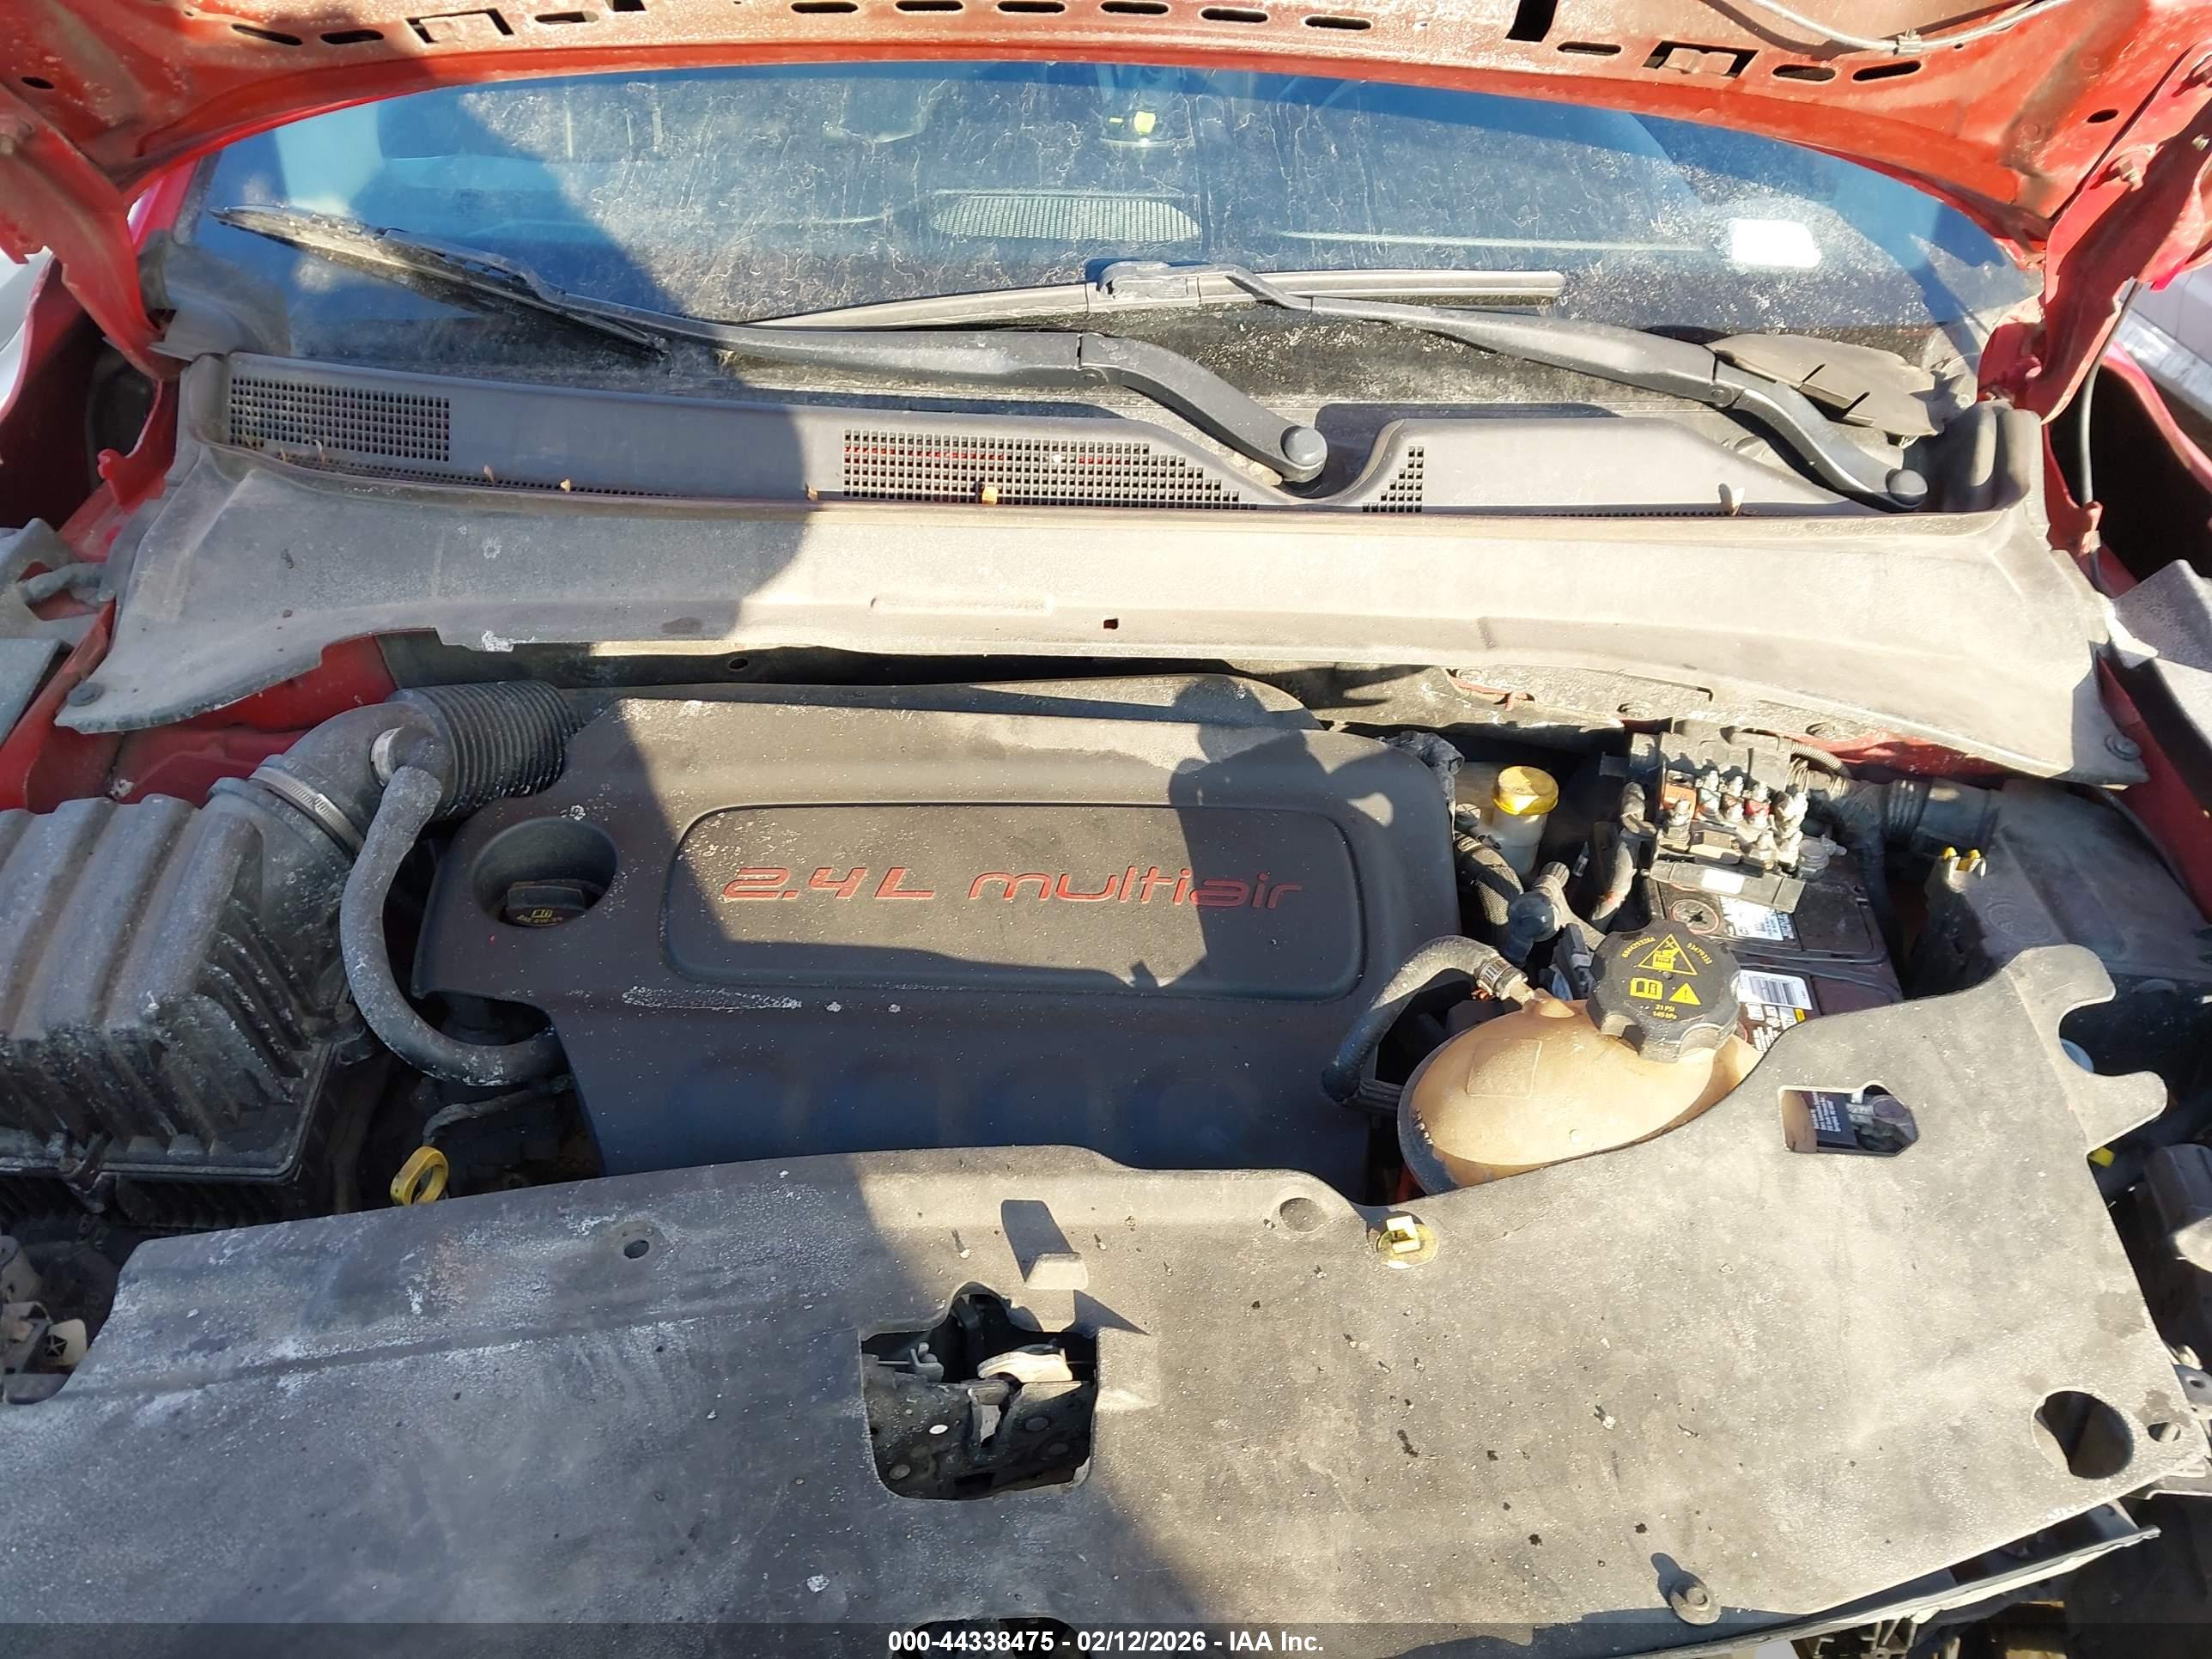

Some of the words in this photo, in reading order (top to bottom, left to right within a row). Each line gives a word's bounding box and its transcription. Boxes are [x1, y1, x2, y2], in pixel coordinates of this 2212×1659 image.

[724, 866, 867, 901] 2.4
[874, 866, 935, 900] L
[968, 865, 1302, 909] multiair
